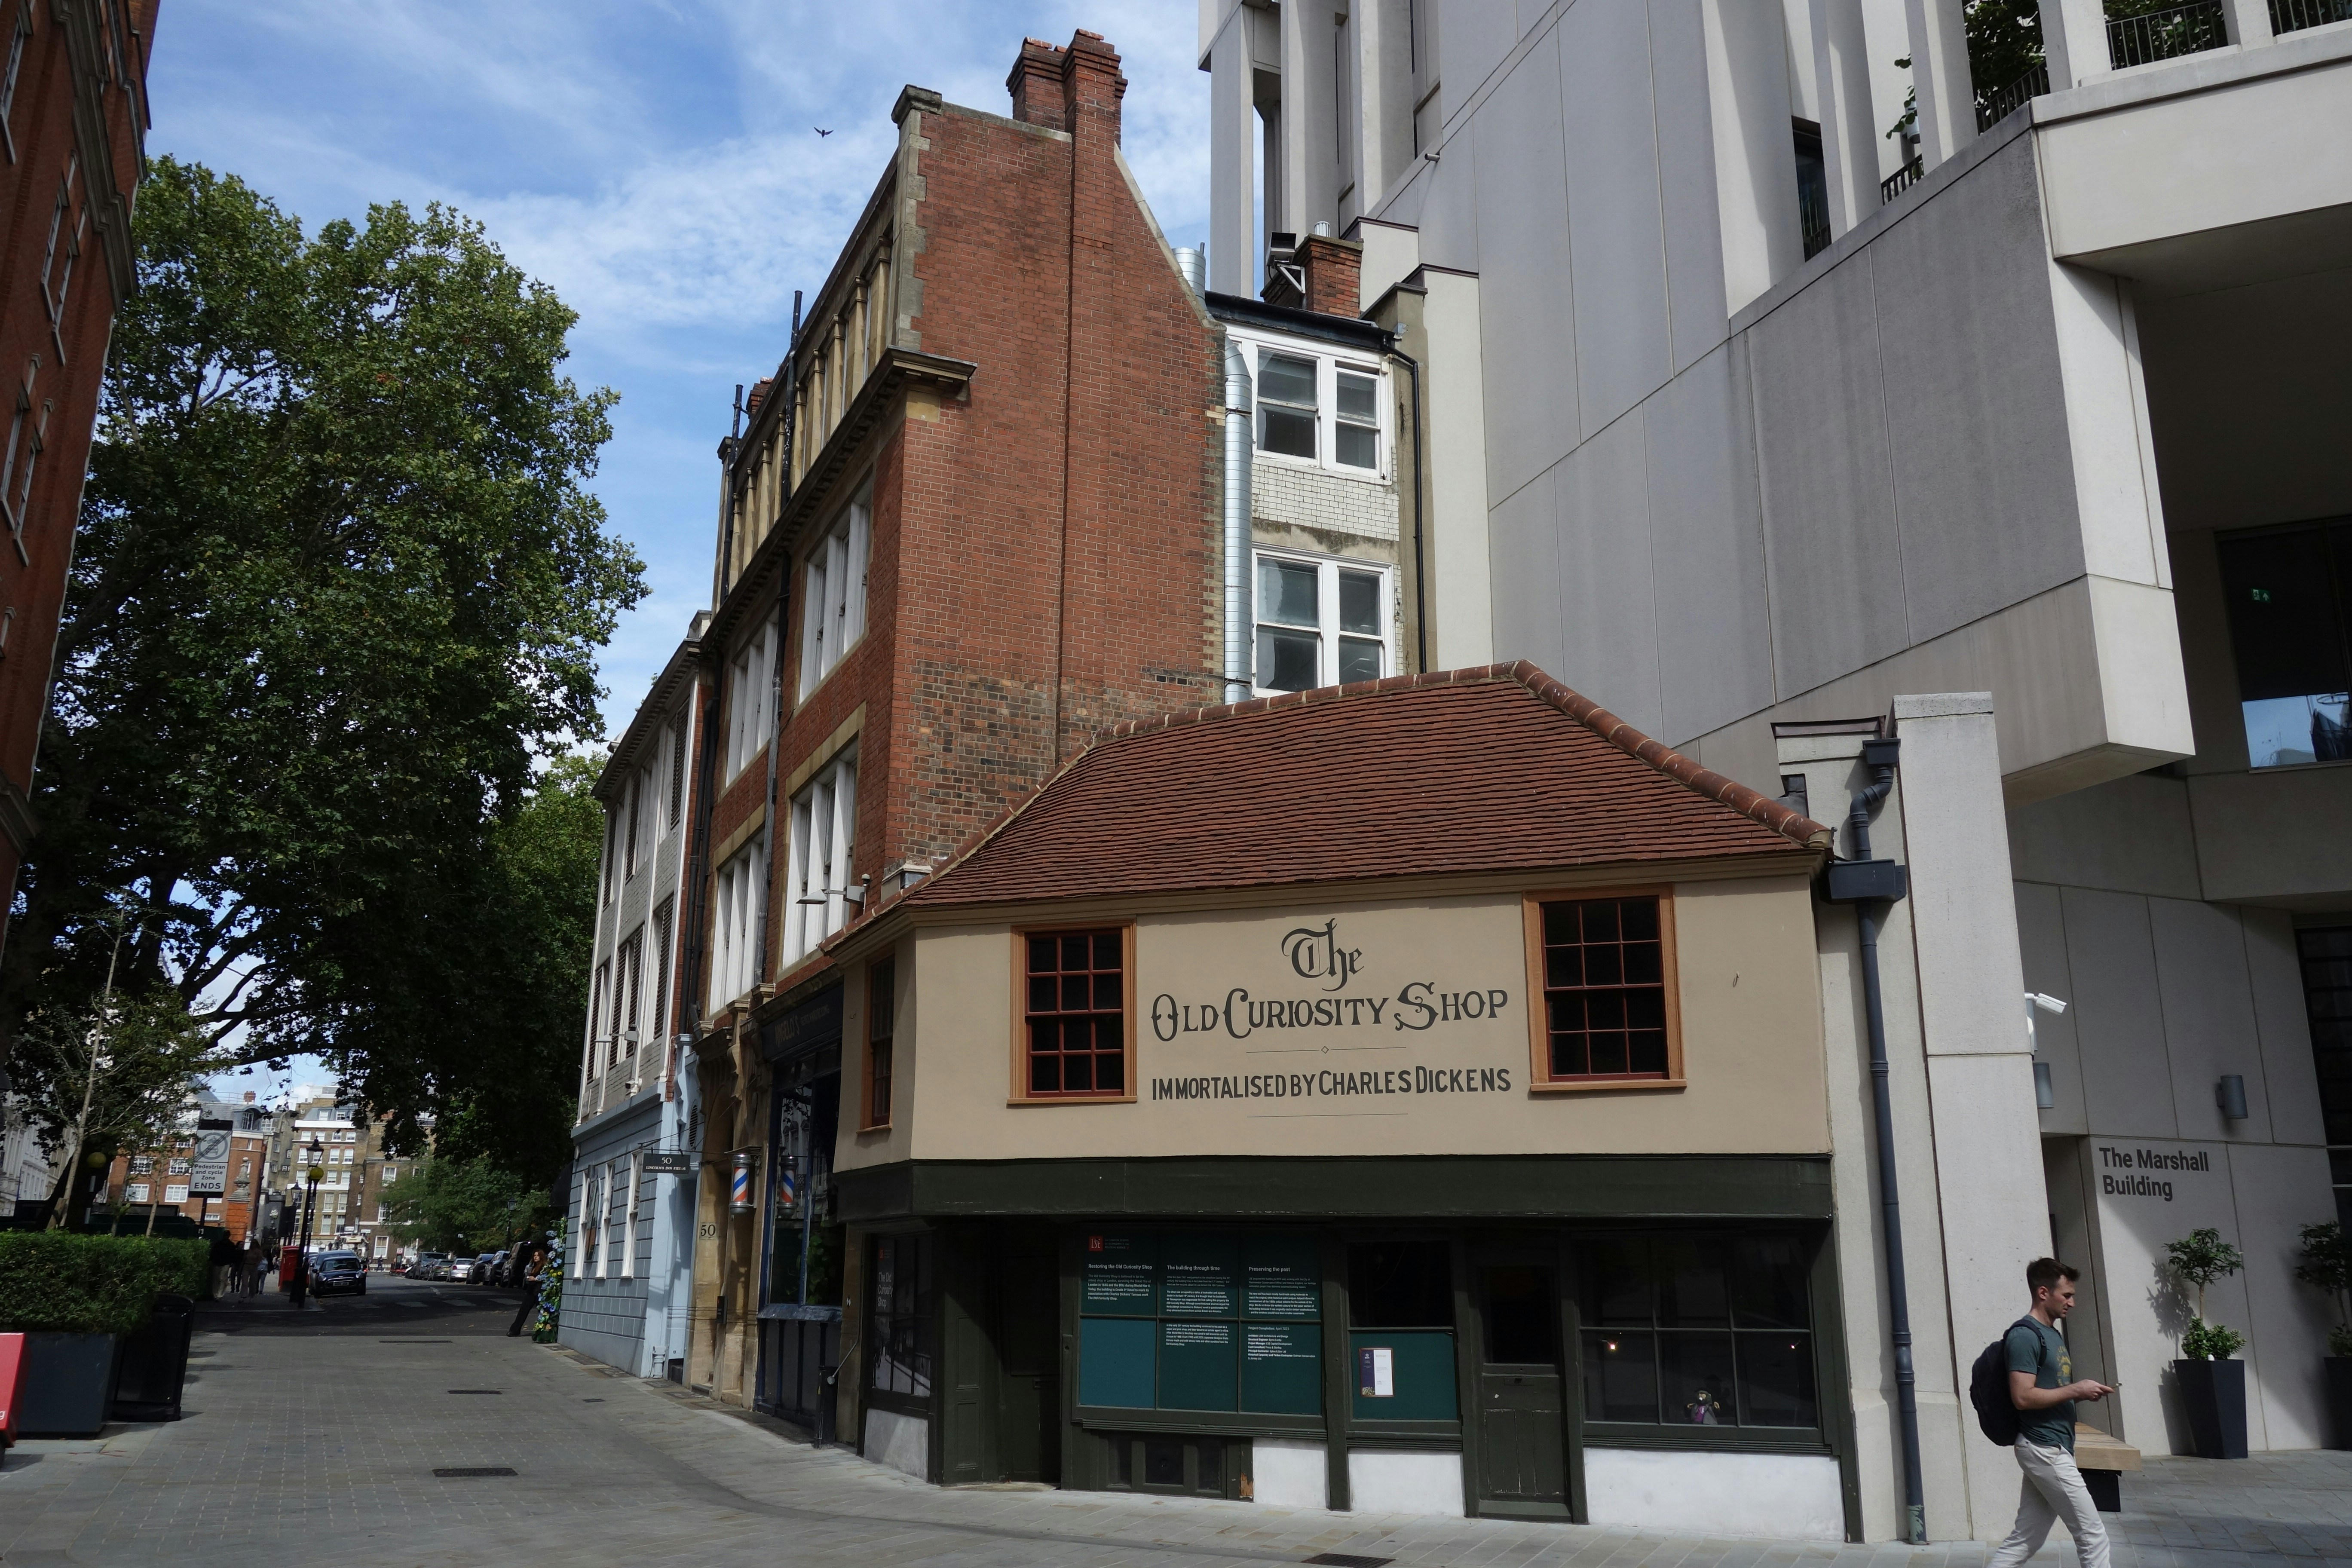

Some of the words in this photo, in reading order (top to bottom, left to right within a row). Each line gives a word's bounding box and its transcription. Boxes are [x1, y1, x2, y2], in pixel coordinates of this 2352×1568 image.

[1282, 918, 1365, 991] The
[1151, 994, 1219, 1041] OLD
[1222, 988, 1389, 1038] CURIOSITY
[1394, 982, 1507, 1031] SHOP
[1153, 1075, 1286, 1100] IMMORTALISED
[1291, 1074, 1316, 1096] BY
[1319, 1070, 1411, 1095] CHARLES
[1416, 1066, 1511, 1093] DICKENS
[2099, 1147, 2132, 1169] The
[2136, 1149, 2209, 1172] Marshall
[2102, 1175, 2173, 1202] Building
[701, 1225, 716, 1236] 50
[1091, 1238, 1100, 1248] LSE
[878, 1285, 893, 1297] Curiosity
[878, 1297, 887, 1309] Shop
